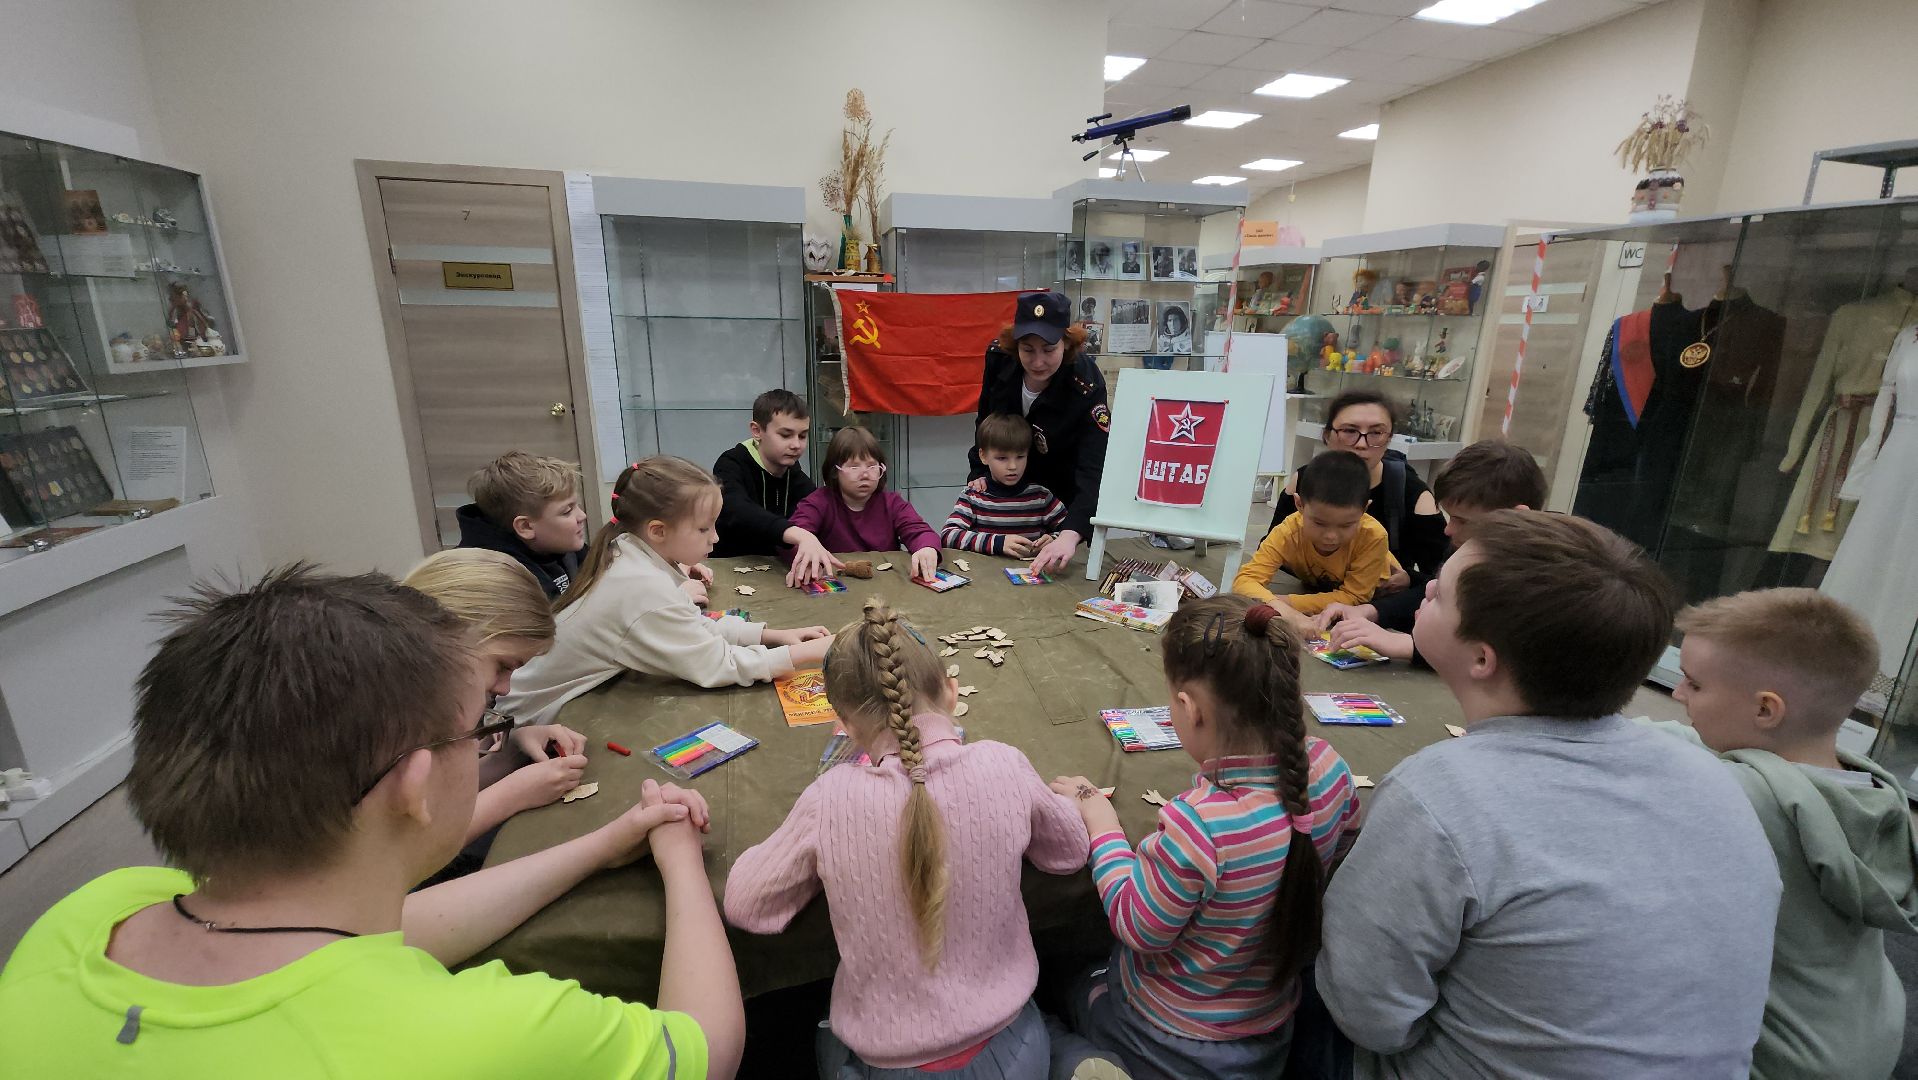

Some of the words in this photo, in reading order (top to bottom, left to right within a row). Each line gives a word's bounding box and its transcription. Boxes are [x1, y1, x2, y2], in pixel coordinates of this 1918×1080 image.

[462, 210, 470, 221] 7
[1624, 247, 1644, 259] WC
[1144, 460, 1210, 484] ШТАБ
